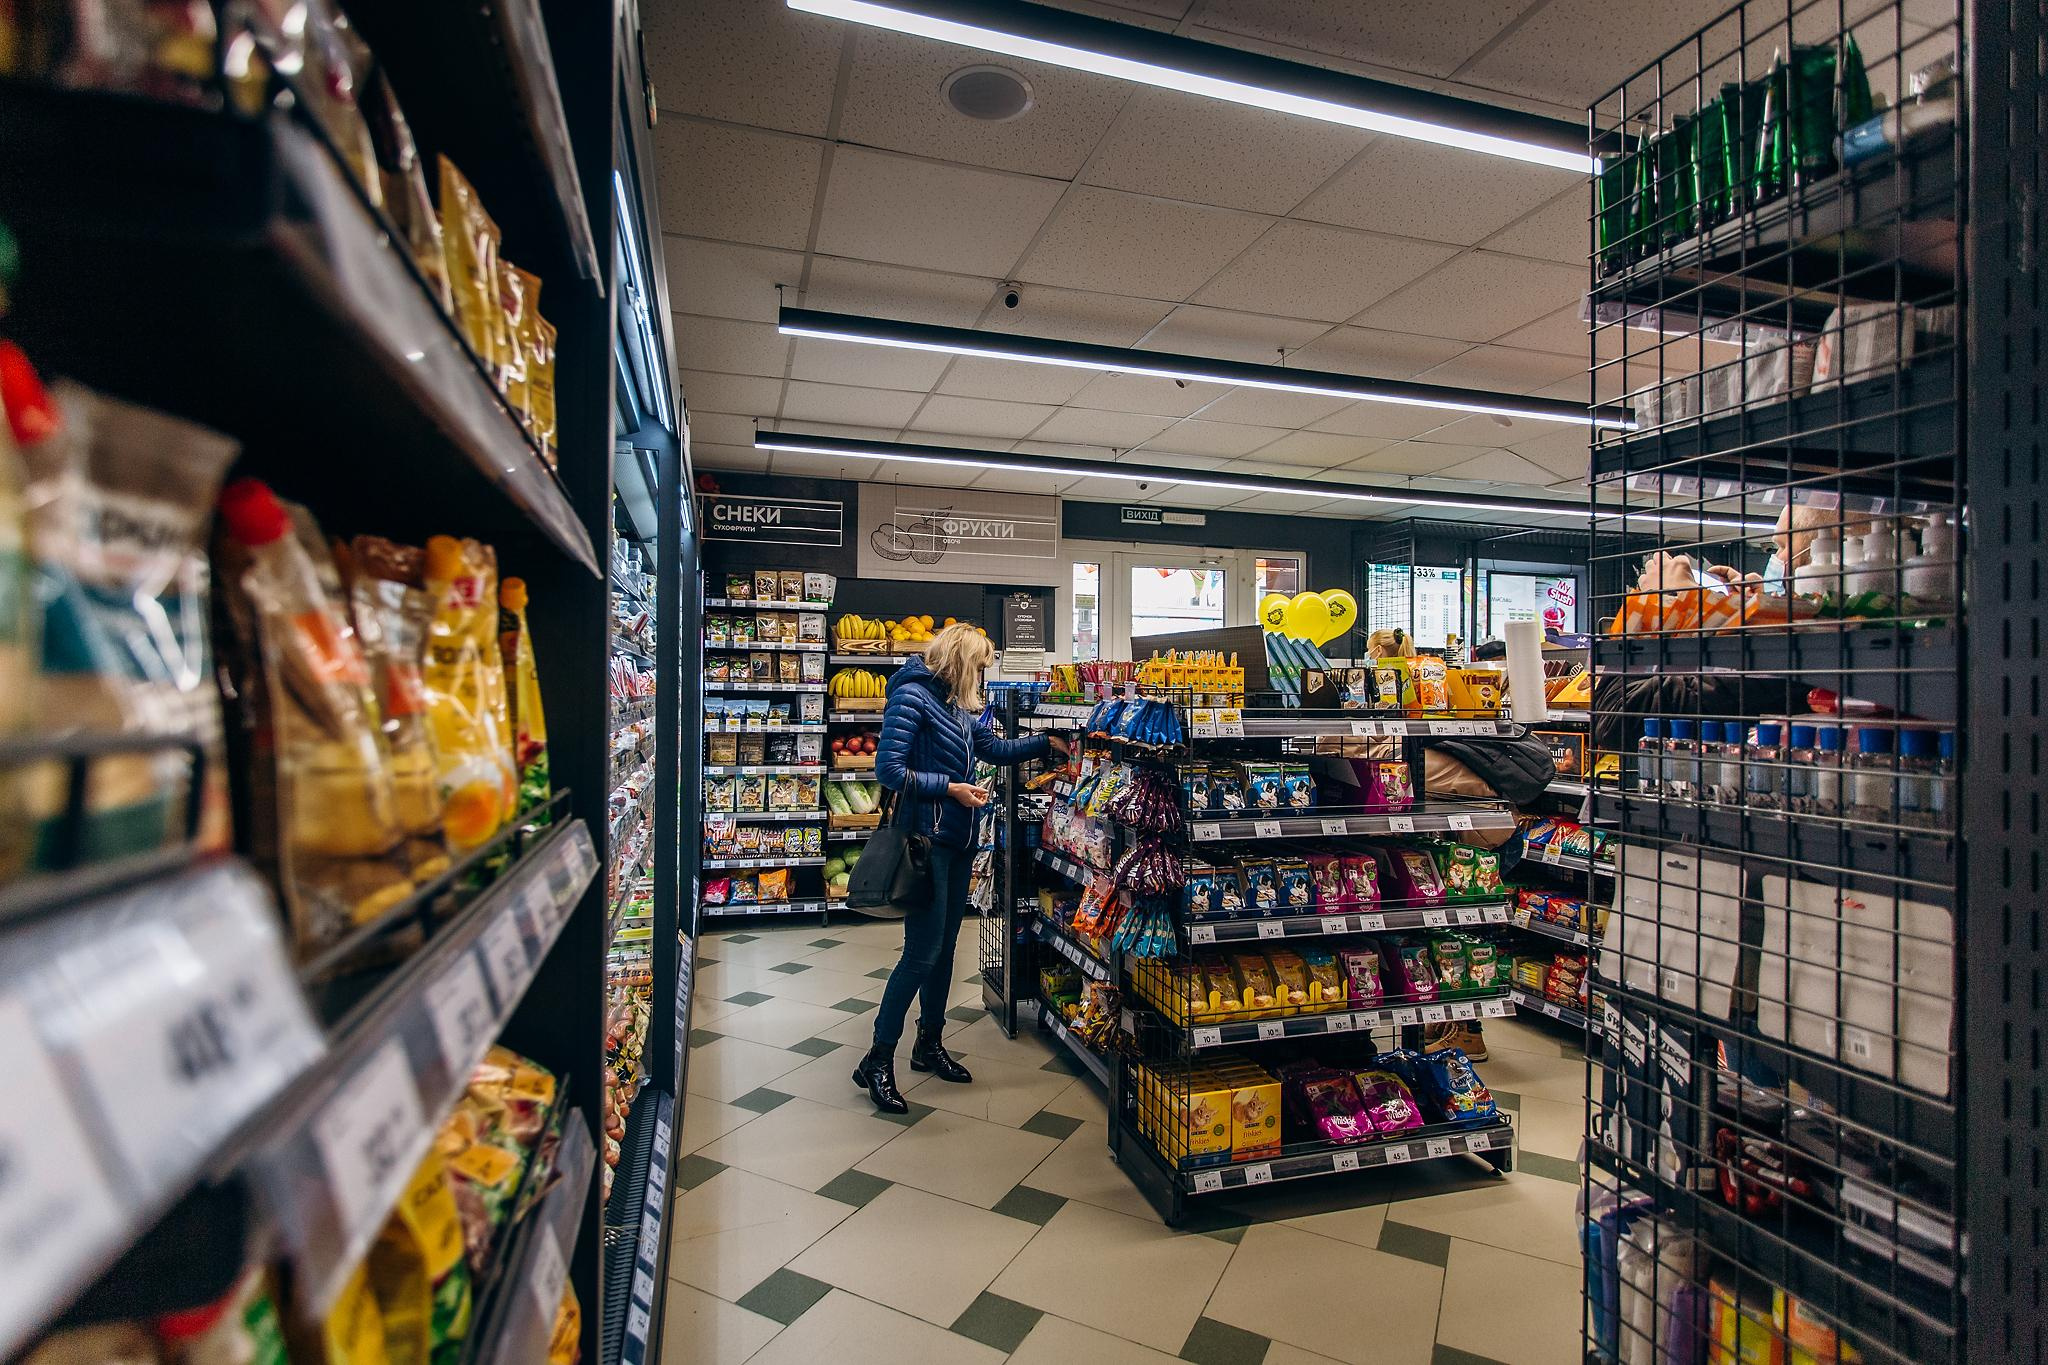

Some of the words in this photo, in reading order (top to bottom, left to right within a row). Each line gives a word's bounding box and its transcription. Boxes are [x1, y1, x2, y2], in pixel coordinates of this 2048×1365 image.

[713, 504, 781, 524] СНЕКИ
[1126, 510, 1158, 520] ВИХІД
[713, 524, 756, 533] СУХОФРУКТИ
[942, 520, 1014, 538] ФРУКТИ
[1550, 588, 1574, 606] Slush
[1242, 1130, 1262, 1139] friskies
